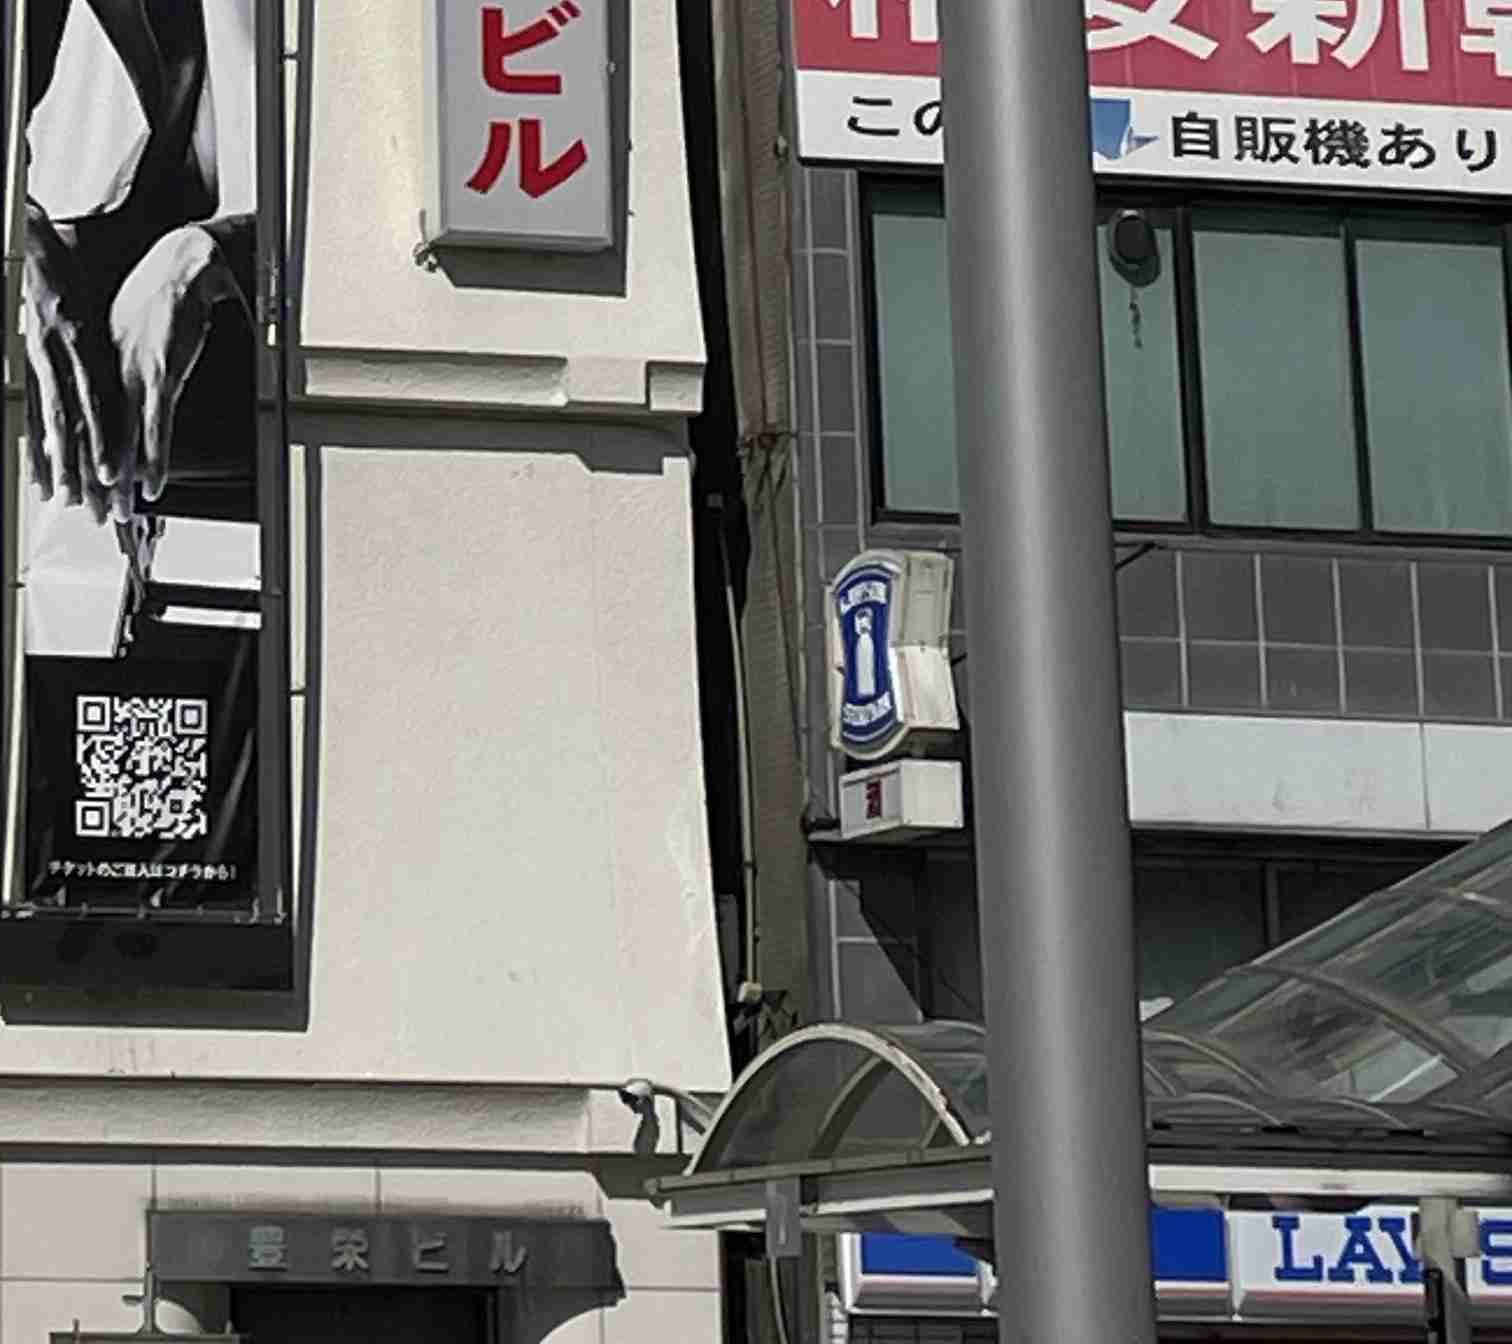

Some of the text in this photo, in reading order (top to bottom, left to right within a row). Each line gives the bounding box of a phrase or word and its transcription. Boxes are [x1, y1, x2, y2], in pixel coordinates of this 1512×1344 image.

[1171, 112, 1497, 174] 自販機あり
[246, 1225, 528, 1273] 豊栄ビル
